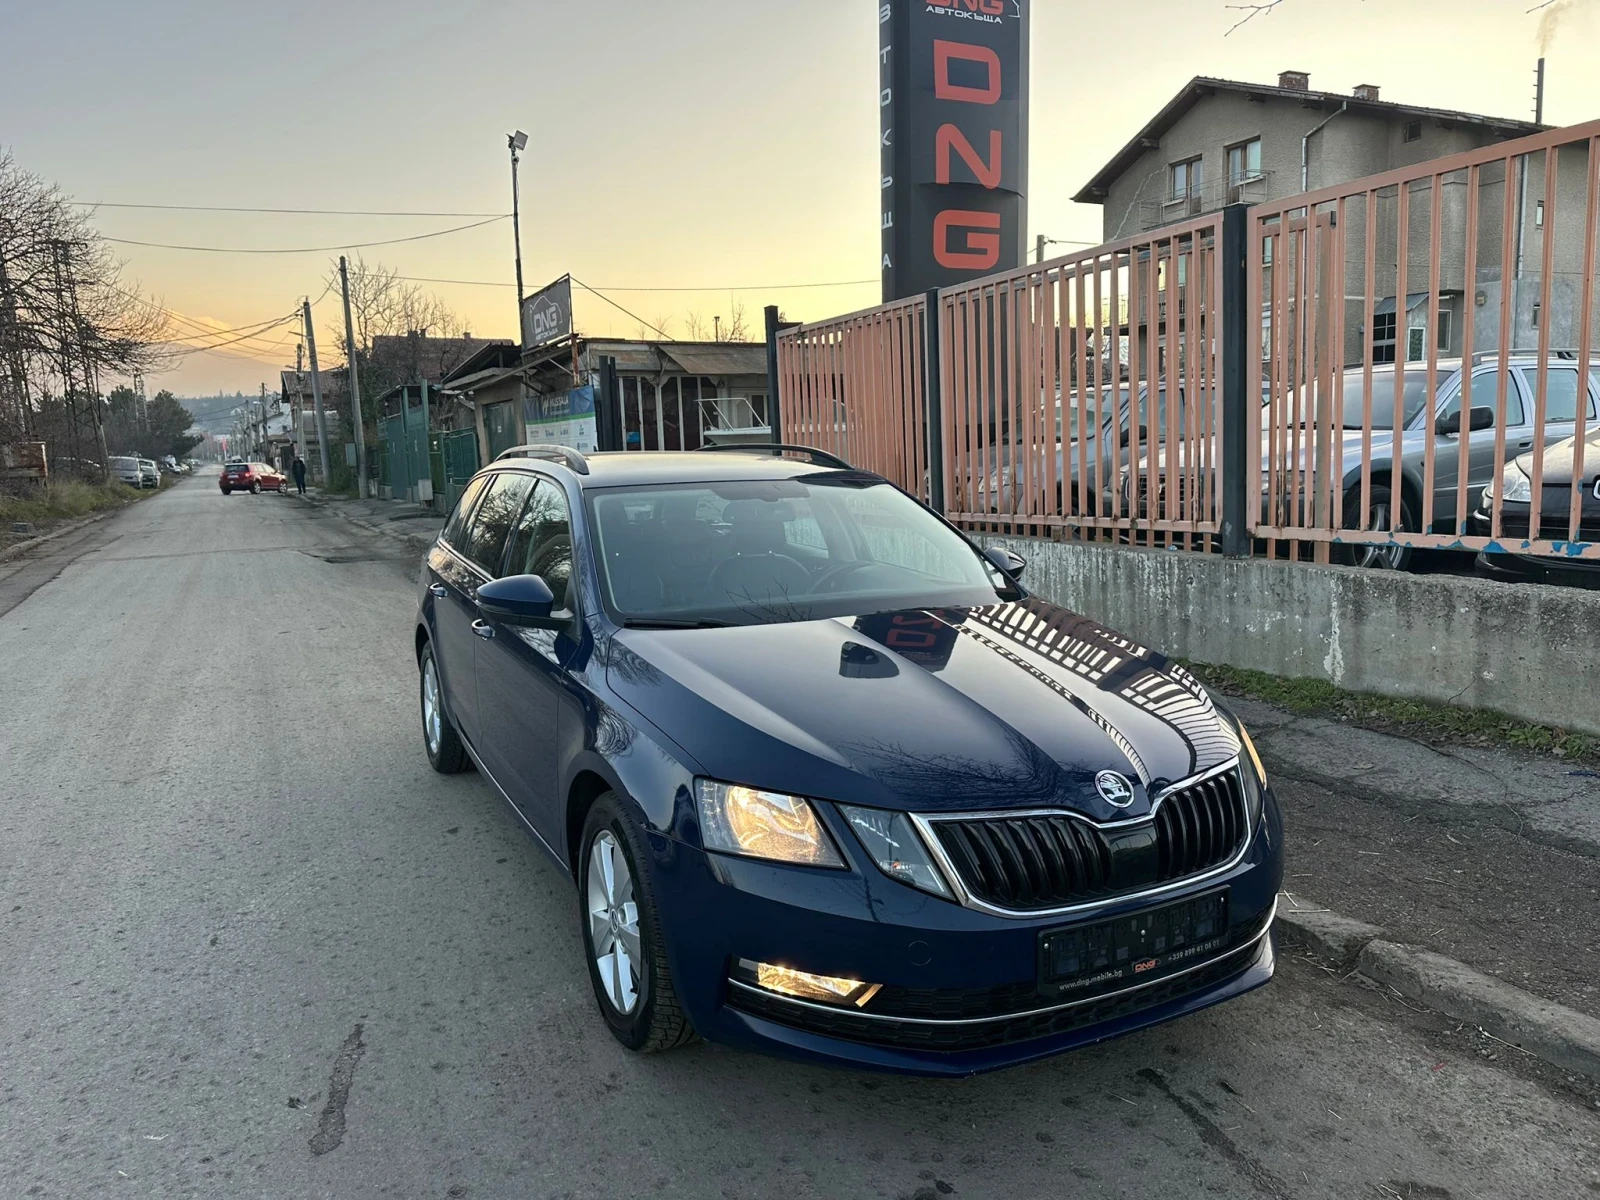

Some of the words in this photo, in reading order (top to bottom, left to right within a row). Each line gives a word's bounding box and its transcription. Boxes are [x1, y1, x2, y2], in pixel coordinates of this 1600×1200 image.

[926, 5, 1002, 24] АВТОКЪЩА
[933, 39, 1001, 270] DNG
[533, 305, 557, 334] DNG
[1168, 951, 1183, 961] +359
[1184, 947, 1196, 957] 899
[1058, 969, 1123, 990] www.dng.mobile.bg
[1135, 959, 1156, 971] DNG
